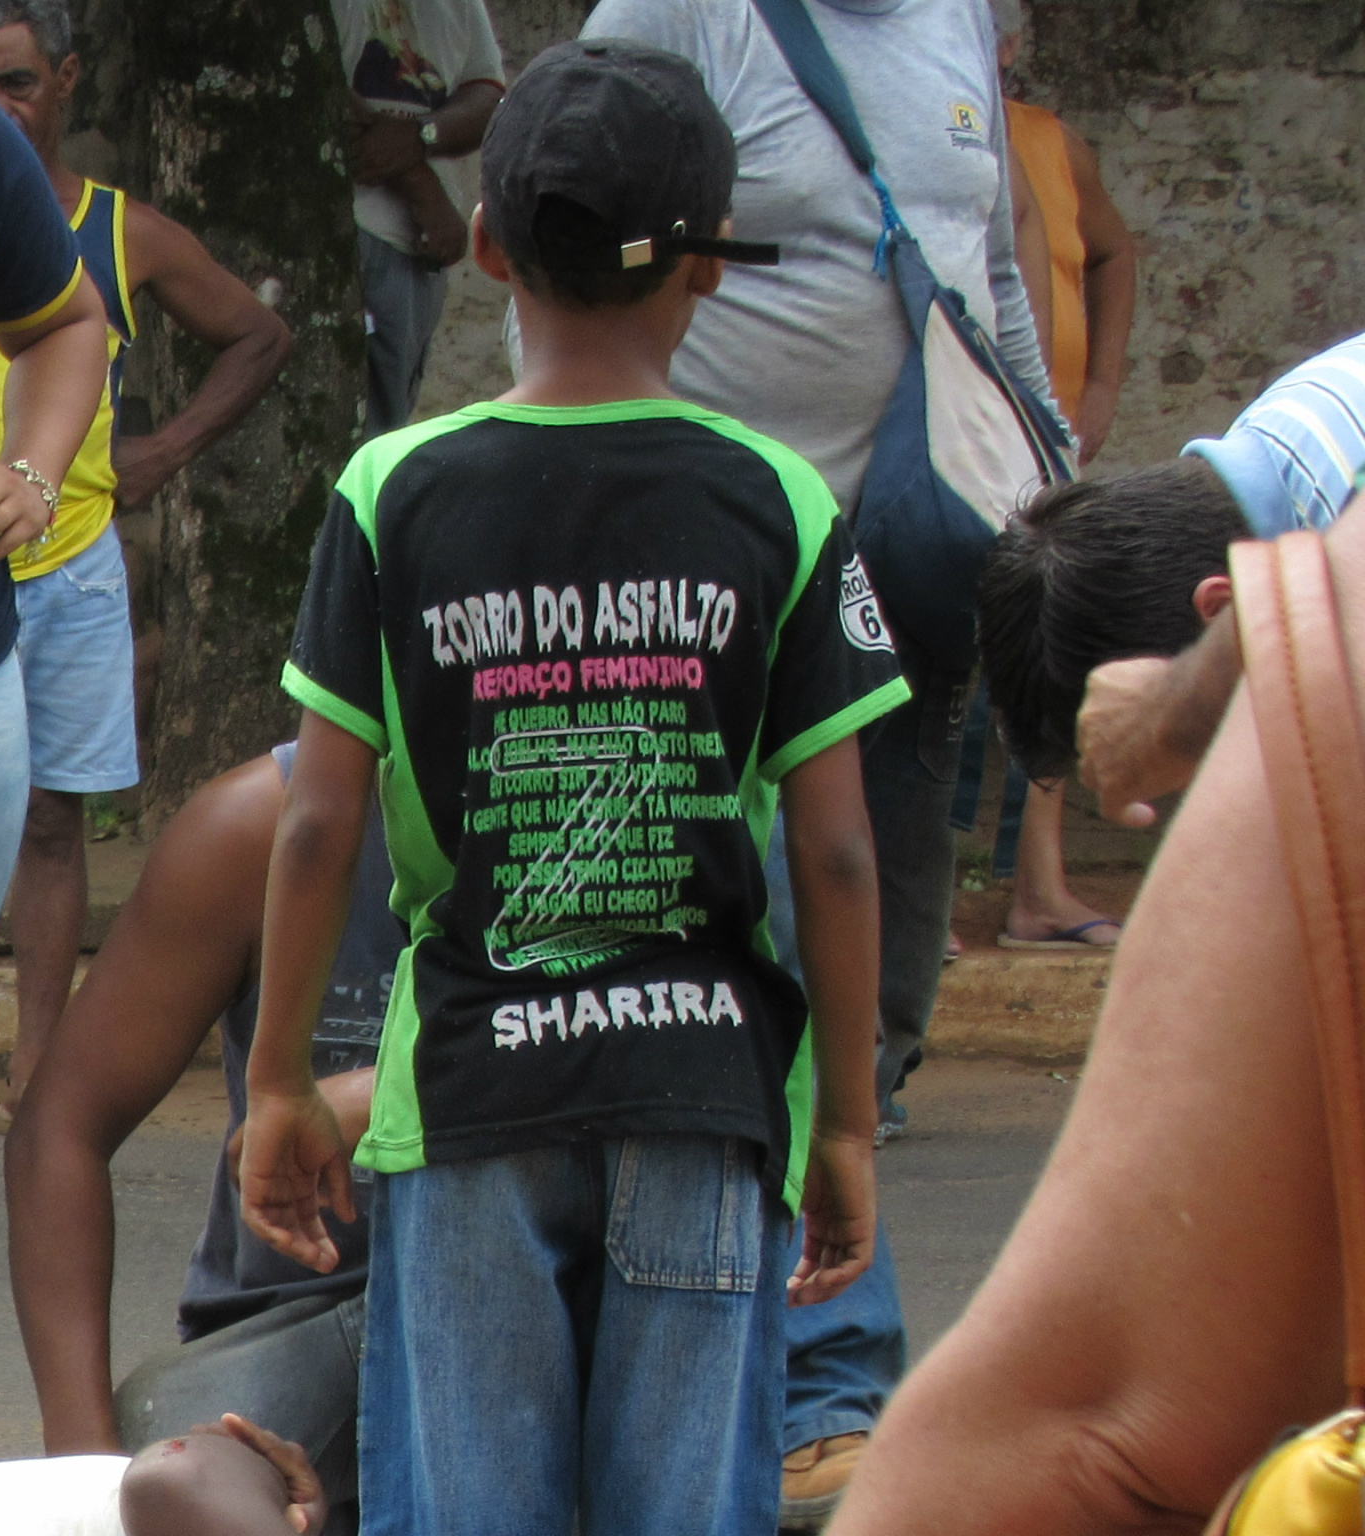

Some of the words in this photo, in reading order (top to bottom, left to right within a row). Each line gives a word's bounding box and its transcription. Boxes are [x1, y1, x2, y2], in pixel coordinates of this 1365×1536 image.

[423, 591, 523, 667] ZORRO
[533, 584, 583, 653] DO
[595, 578, 736, 654] ASFALTO
[473, 660, 571, 699] REFORÇO
[580, 656, 704, 693] FEMININO
[577, 702, 609, 726] MAS
[611, 696, 645, 726] NÃO
[648, 700, 687, 726] PARO
[566, 733, 599, 757] MAS
[637, 732, 687, 757] GASTO
[489, 774, 502, 799] EU
[505, 768, 554, 797] CORRO
[630, 762, 697, 788] VIVENDO
[473, 803, 508, 834] GENTE
[511, 800, 541, 831] QUE
[545, 794, 578, 823] NÃO
[582, 796, 629, 820] CORRE
[645, 788, 667, 821] TÁ
[508, 829, 566, 857] SEMPRE
[569, 827, 595, 855] FIZ
[615, 826, 645, 856] QUE
[648, 825, 674, 851] FIZ
[493, 864, 521, 889] POR
[527, 861, 563, 887] ISSO
[568, 858, 617, 886] TENHO
[621, 855, 694, 884] CICATRIZ
[504, 894, 523, 919] DE
[527, 892, 580, 917] VAGAR
[583, 890, 604, 915] EU
[607, 888, 658, 913] CHEGO
[491, 982, 744, 1050] SHARIRA
